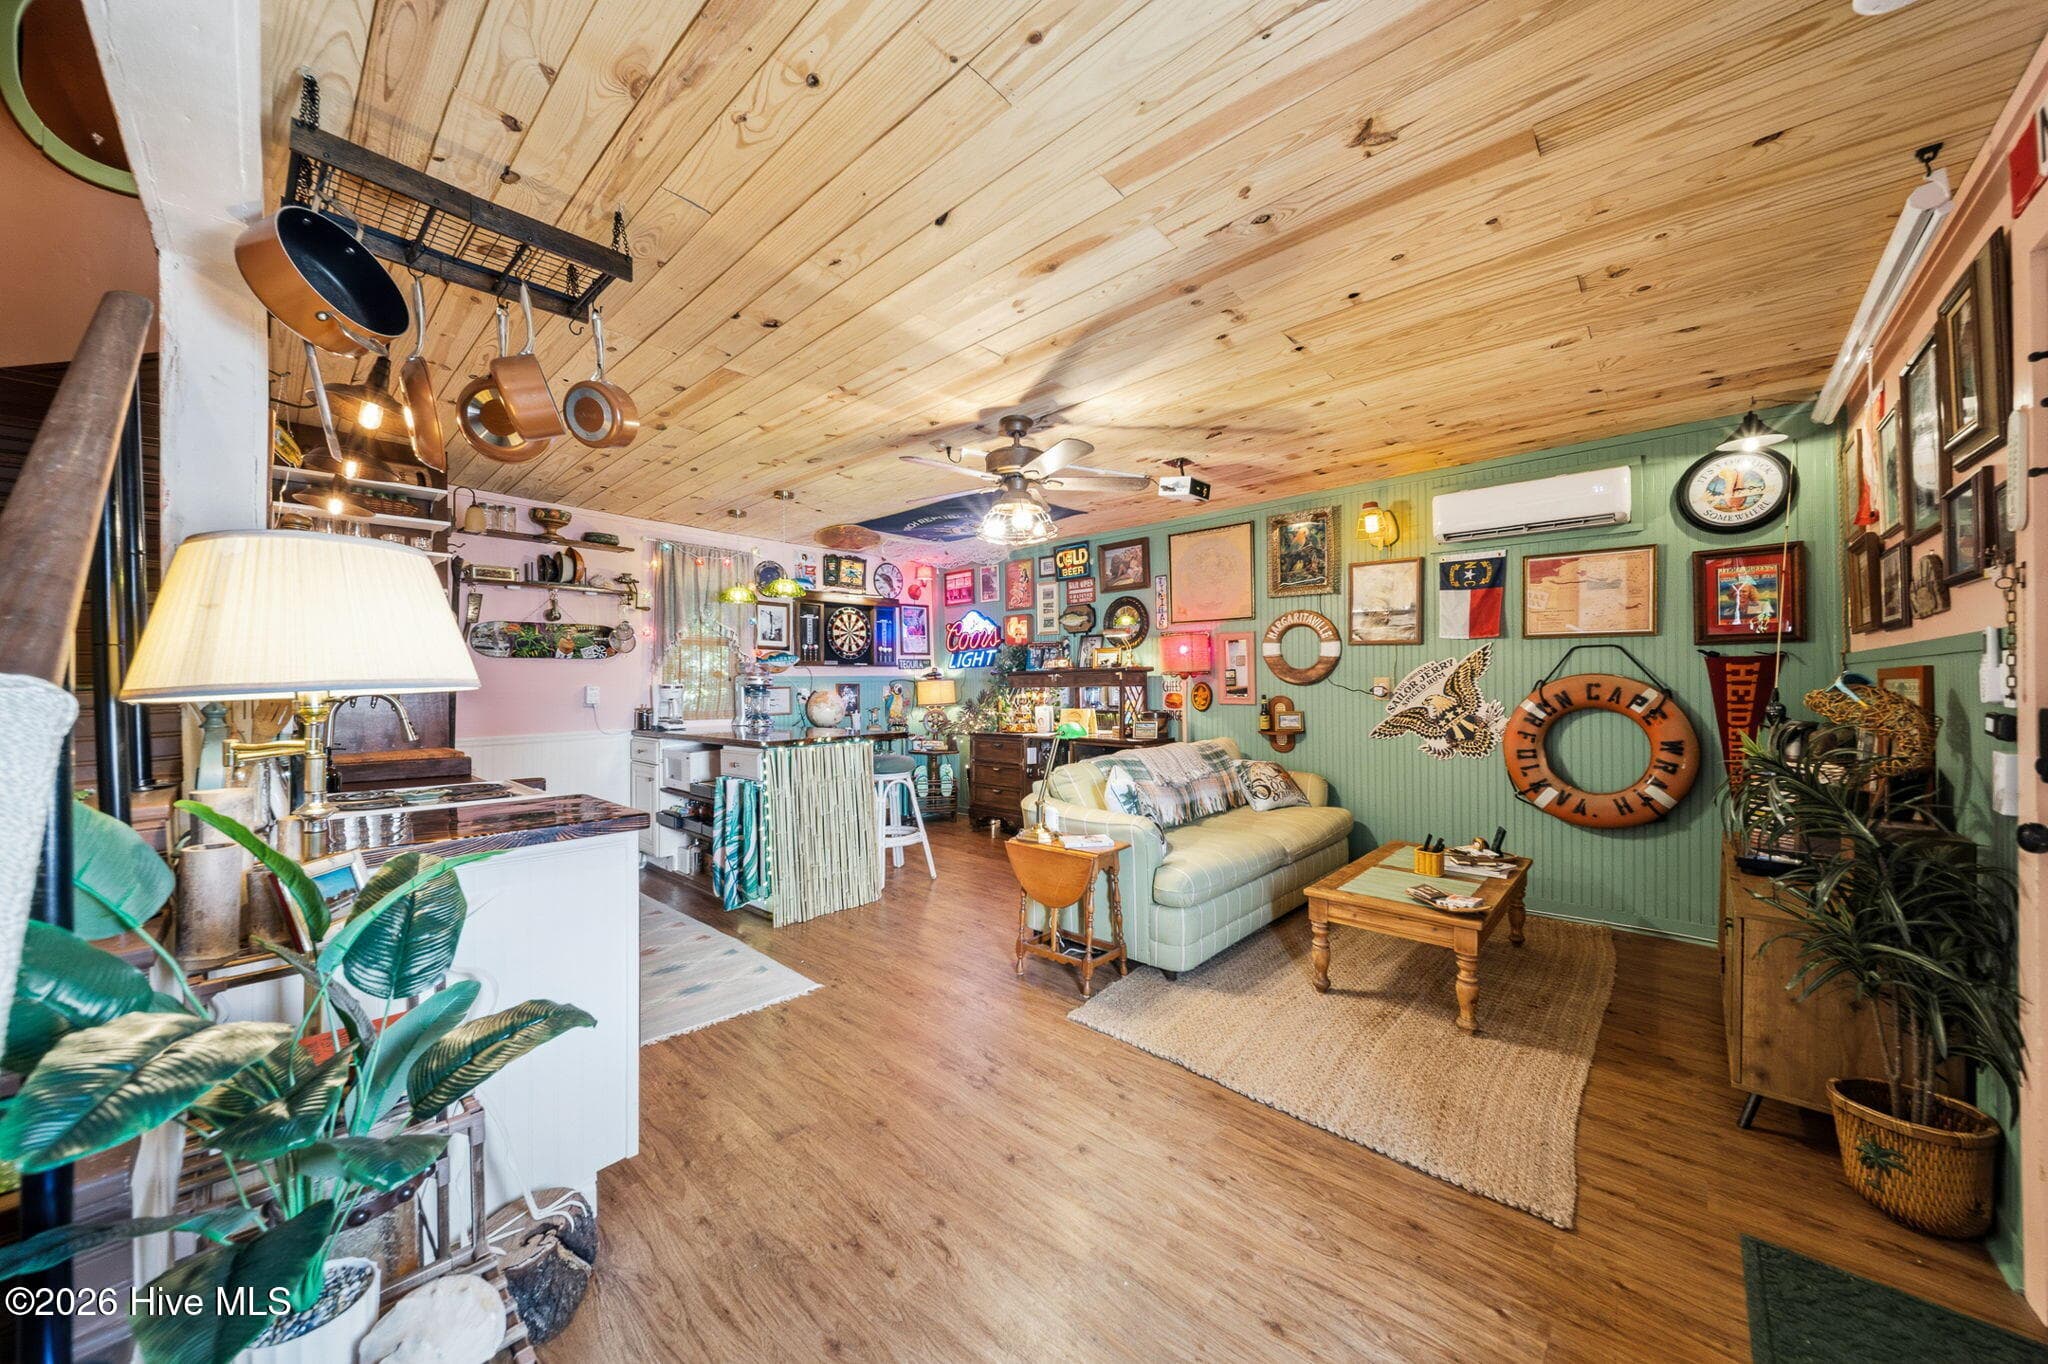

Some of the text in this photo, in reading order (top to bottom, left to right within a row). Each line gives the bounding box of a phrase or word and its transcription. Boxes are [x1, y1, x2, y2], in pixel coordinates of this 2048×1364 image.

[1056, 548, 1089, 568] COLD
[1062, 565, 1084, 577] BEER
[946, 620, 1001, 652] Coors
[1266, 612, 1333, 640] MARGARITAVILLE
[948, 649, 998, 669] LIGHT
[1387, 658, 1454, 711] SAILOR JERRY
[1402, 671, 1446, 706] SPICED RUM
[1585, 682, 1668, 726] CAPE
